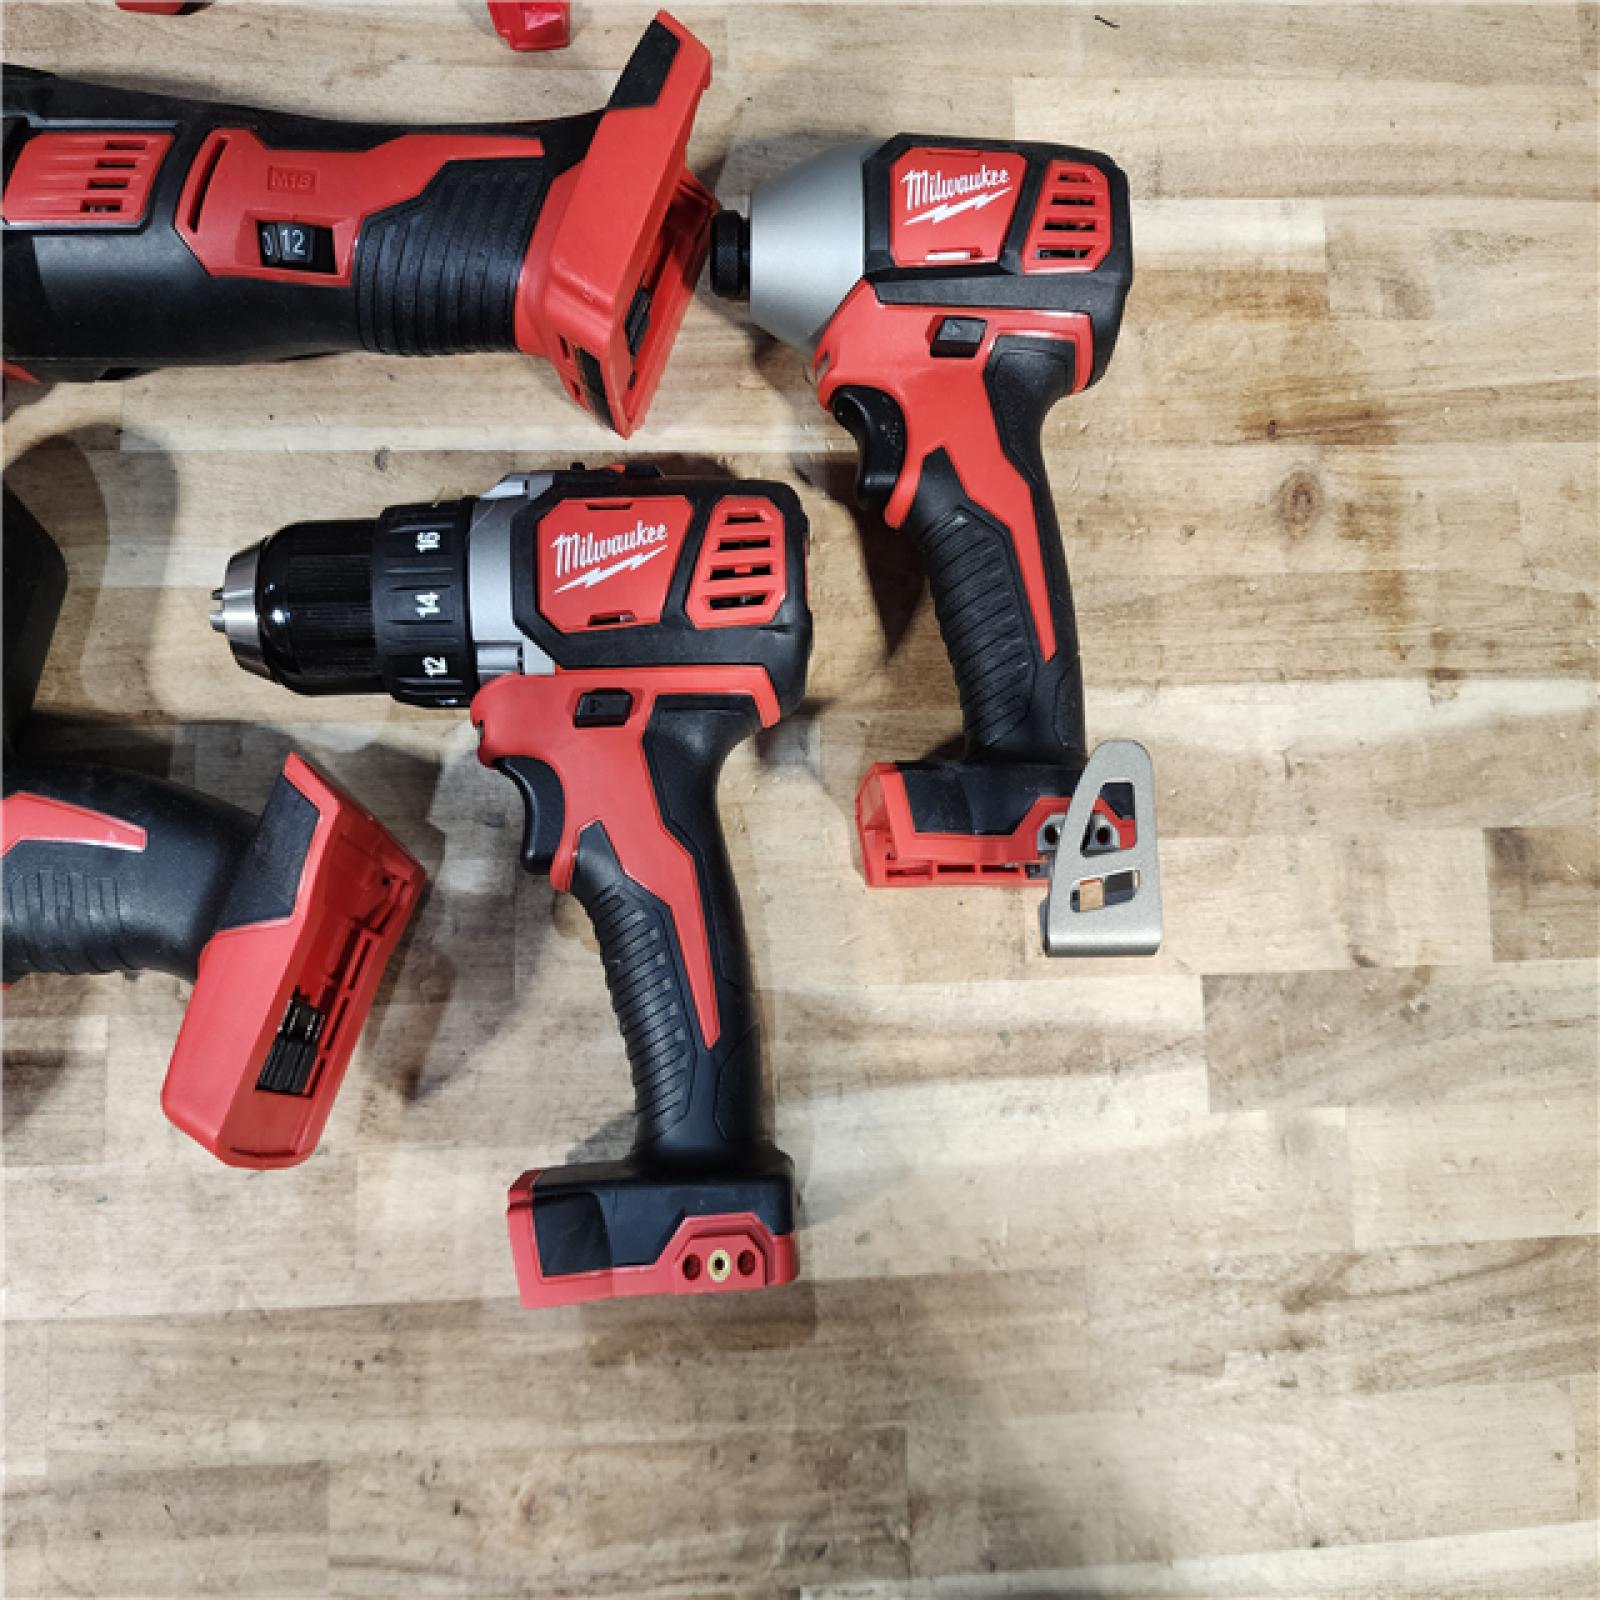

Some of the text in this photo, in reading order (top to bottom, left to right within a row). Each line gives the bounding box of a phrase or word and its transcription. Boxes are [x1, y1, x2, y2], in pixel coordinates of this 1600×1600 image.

[900, 164, 1010, 211] Milwaukee
[281, 229, 306, 256] 12
[550, 519, 667, 578] Milwaukee
[415, 592, 440, 618] 14
[422, 655, 448, 677] 12
